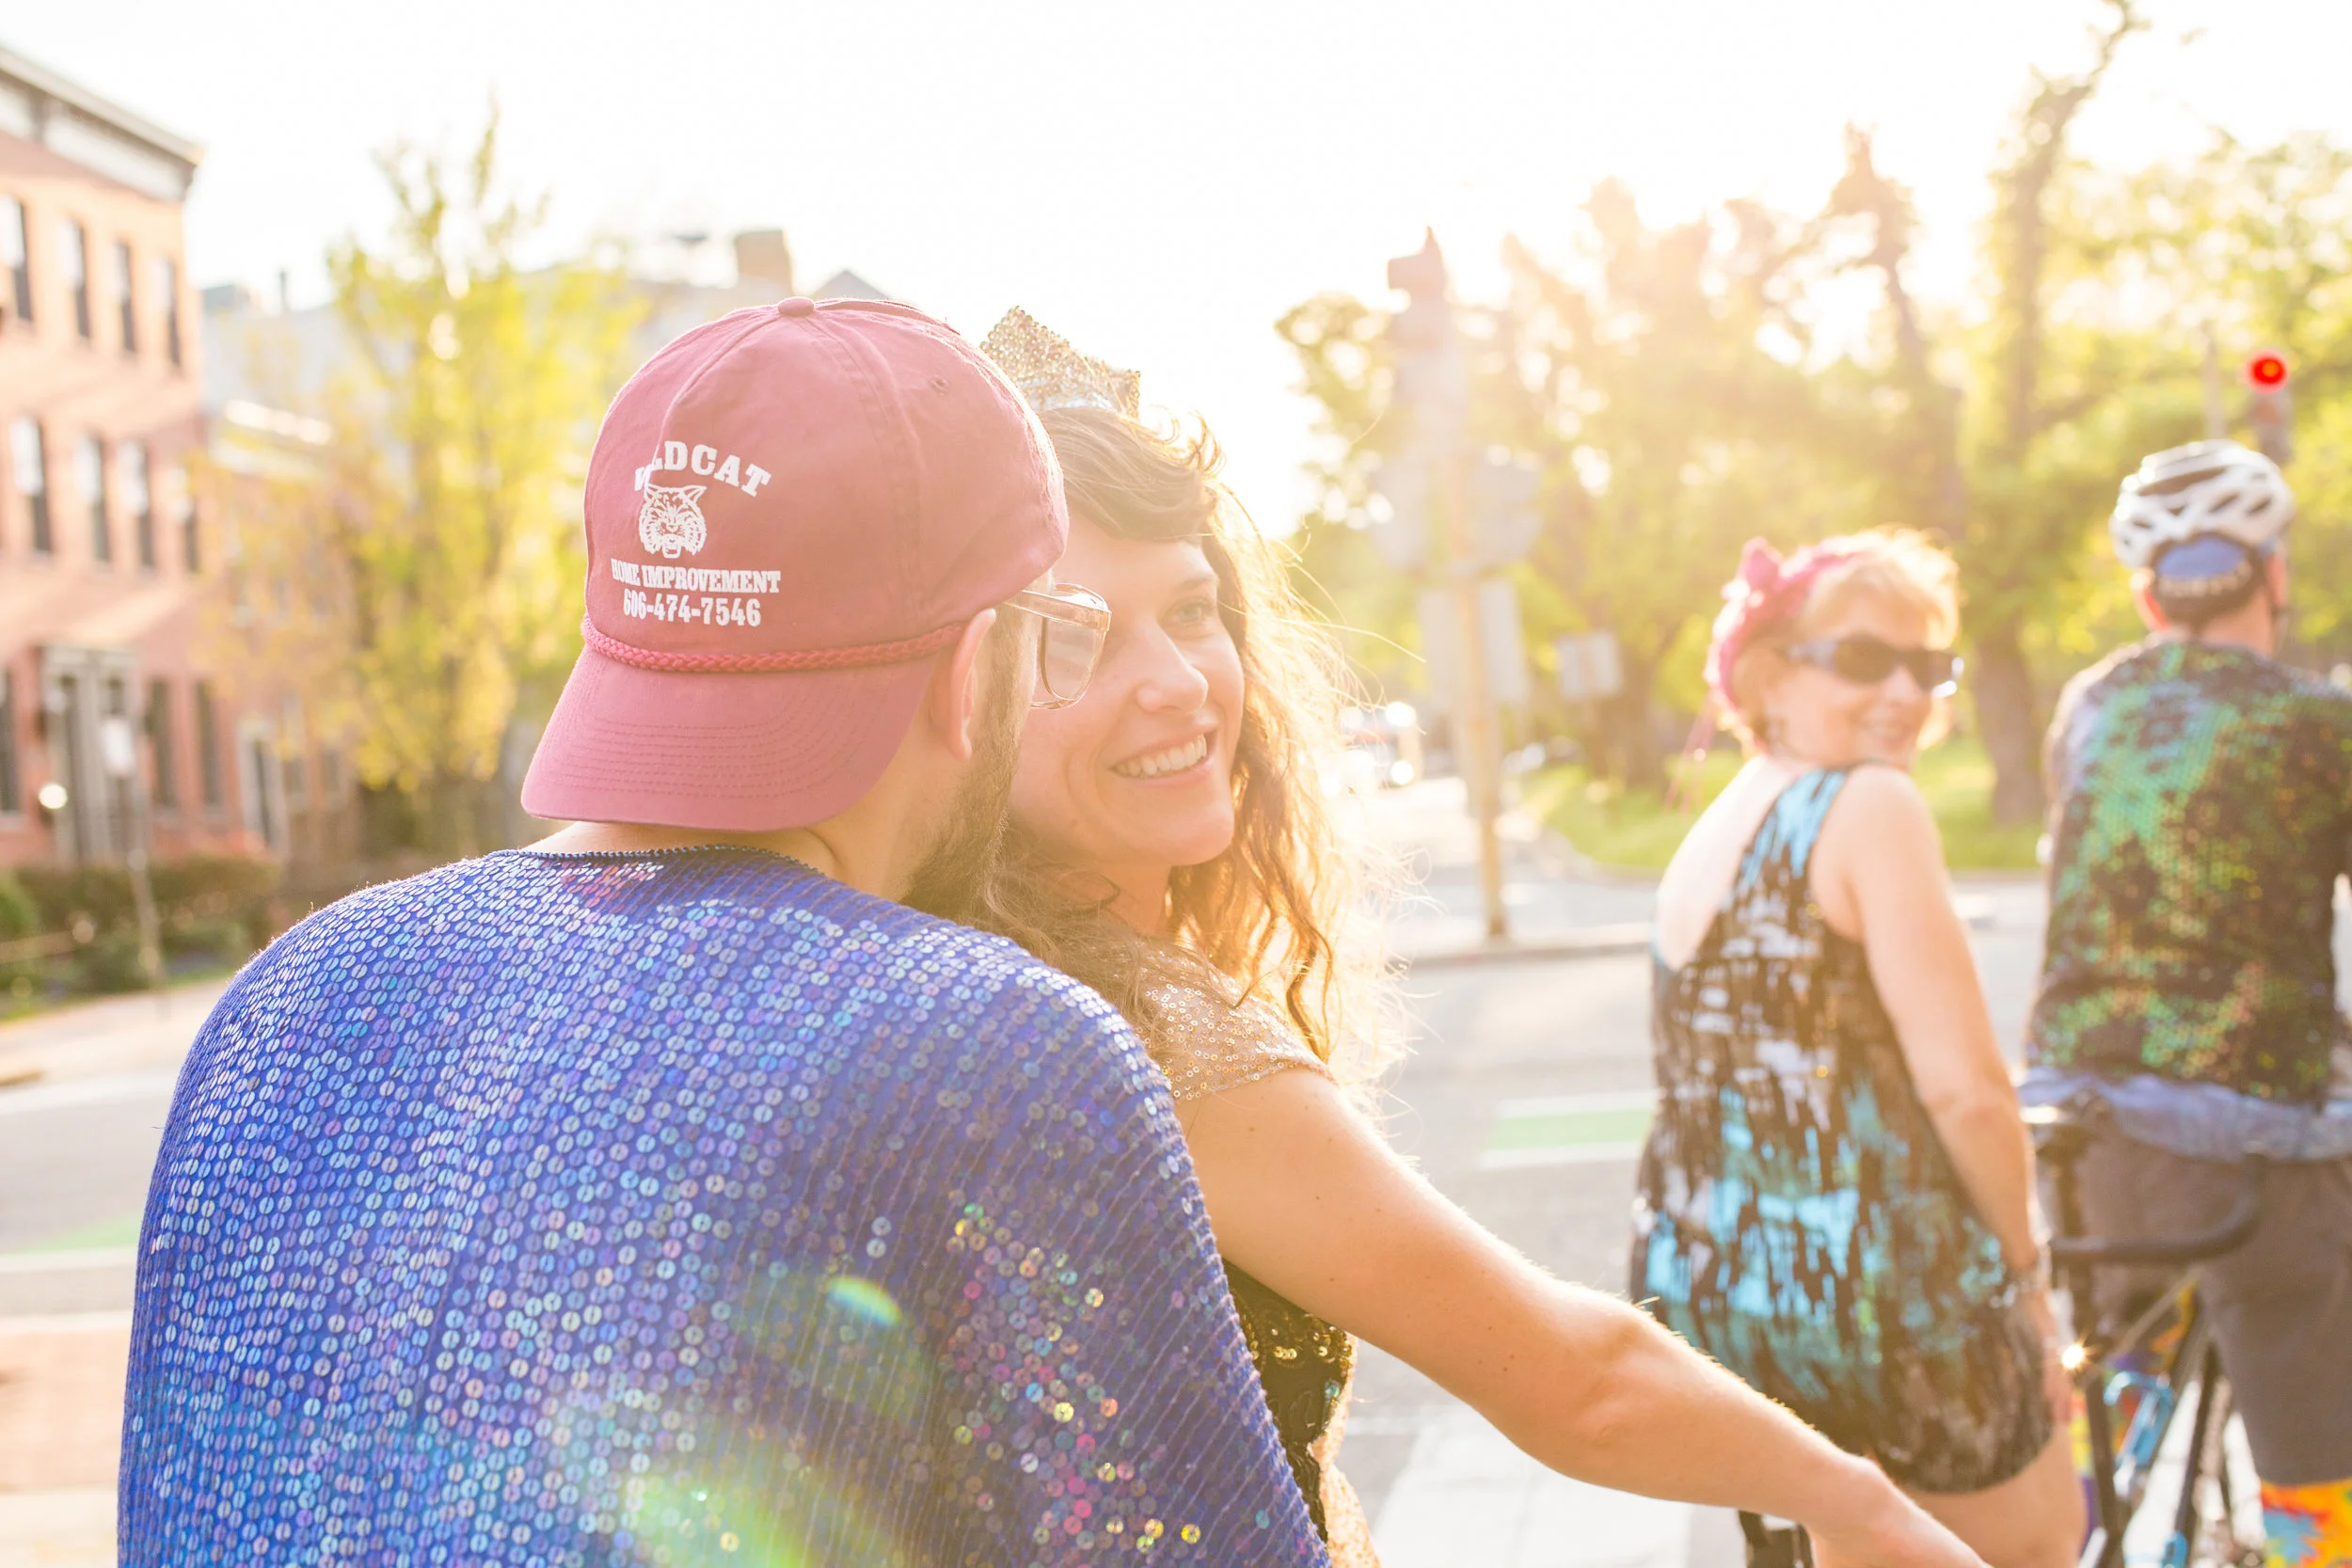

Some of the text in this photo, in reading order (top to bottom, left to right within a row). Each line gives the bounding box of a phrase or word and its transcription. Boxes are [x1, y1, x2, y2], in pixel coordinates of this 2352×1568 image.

[634, 440, 771, 497] WDCAT
[611, 558, 781, 594] HOME IMPROVEMENT
[624, 588, 761, 627] 606-474-7546
